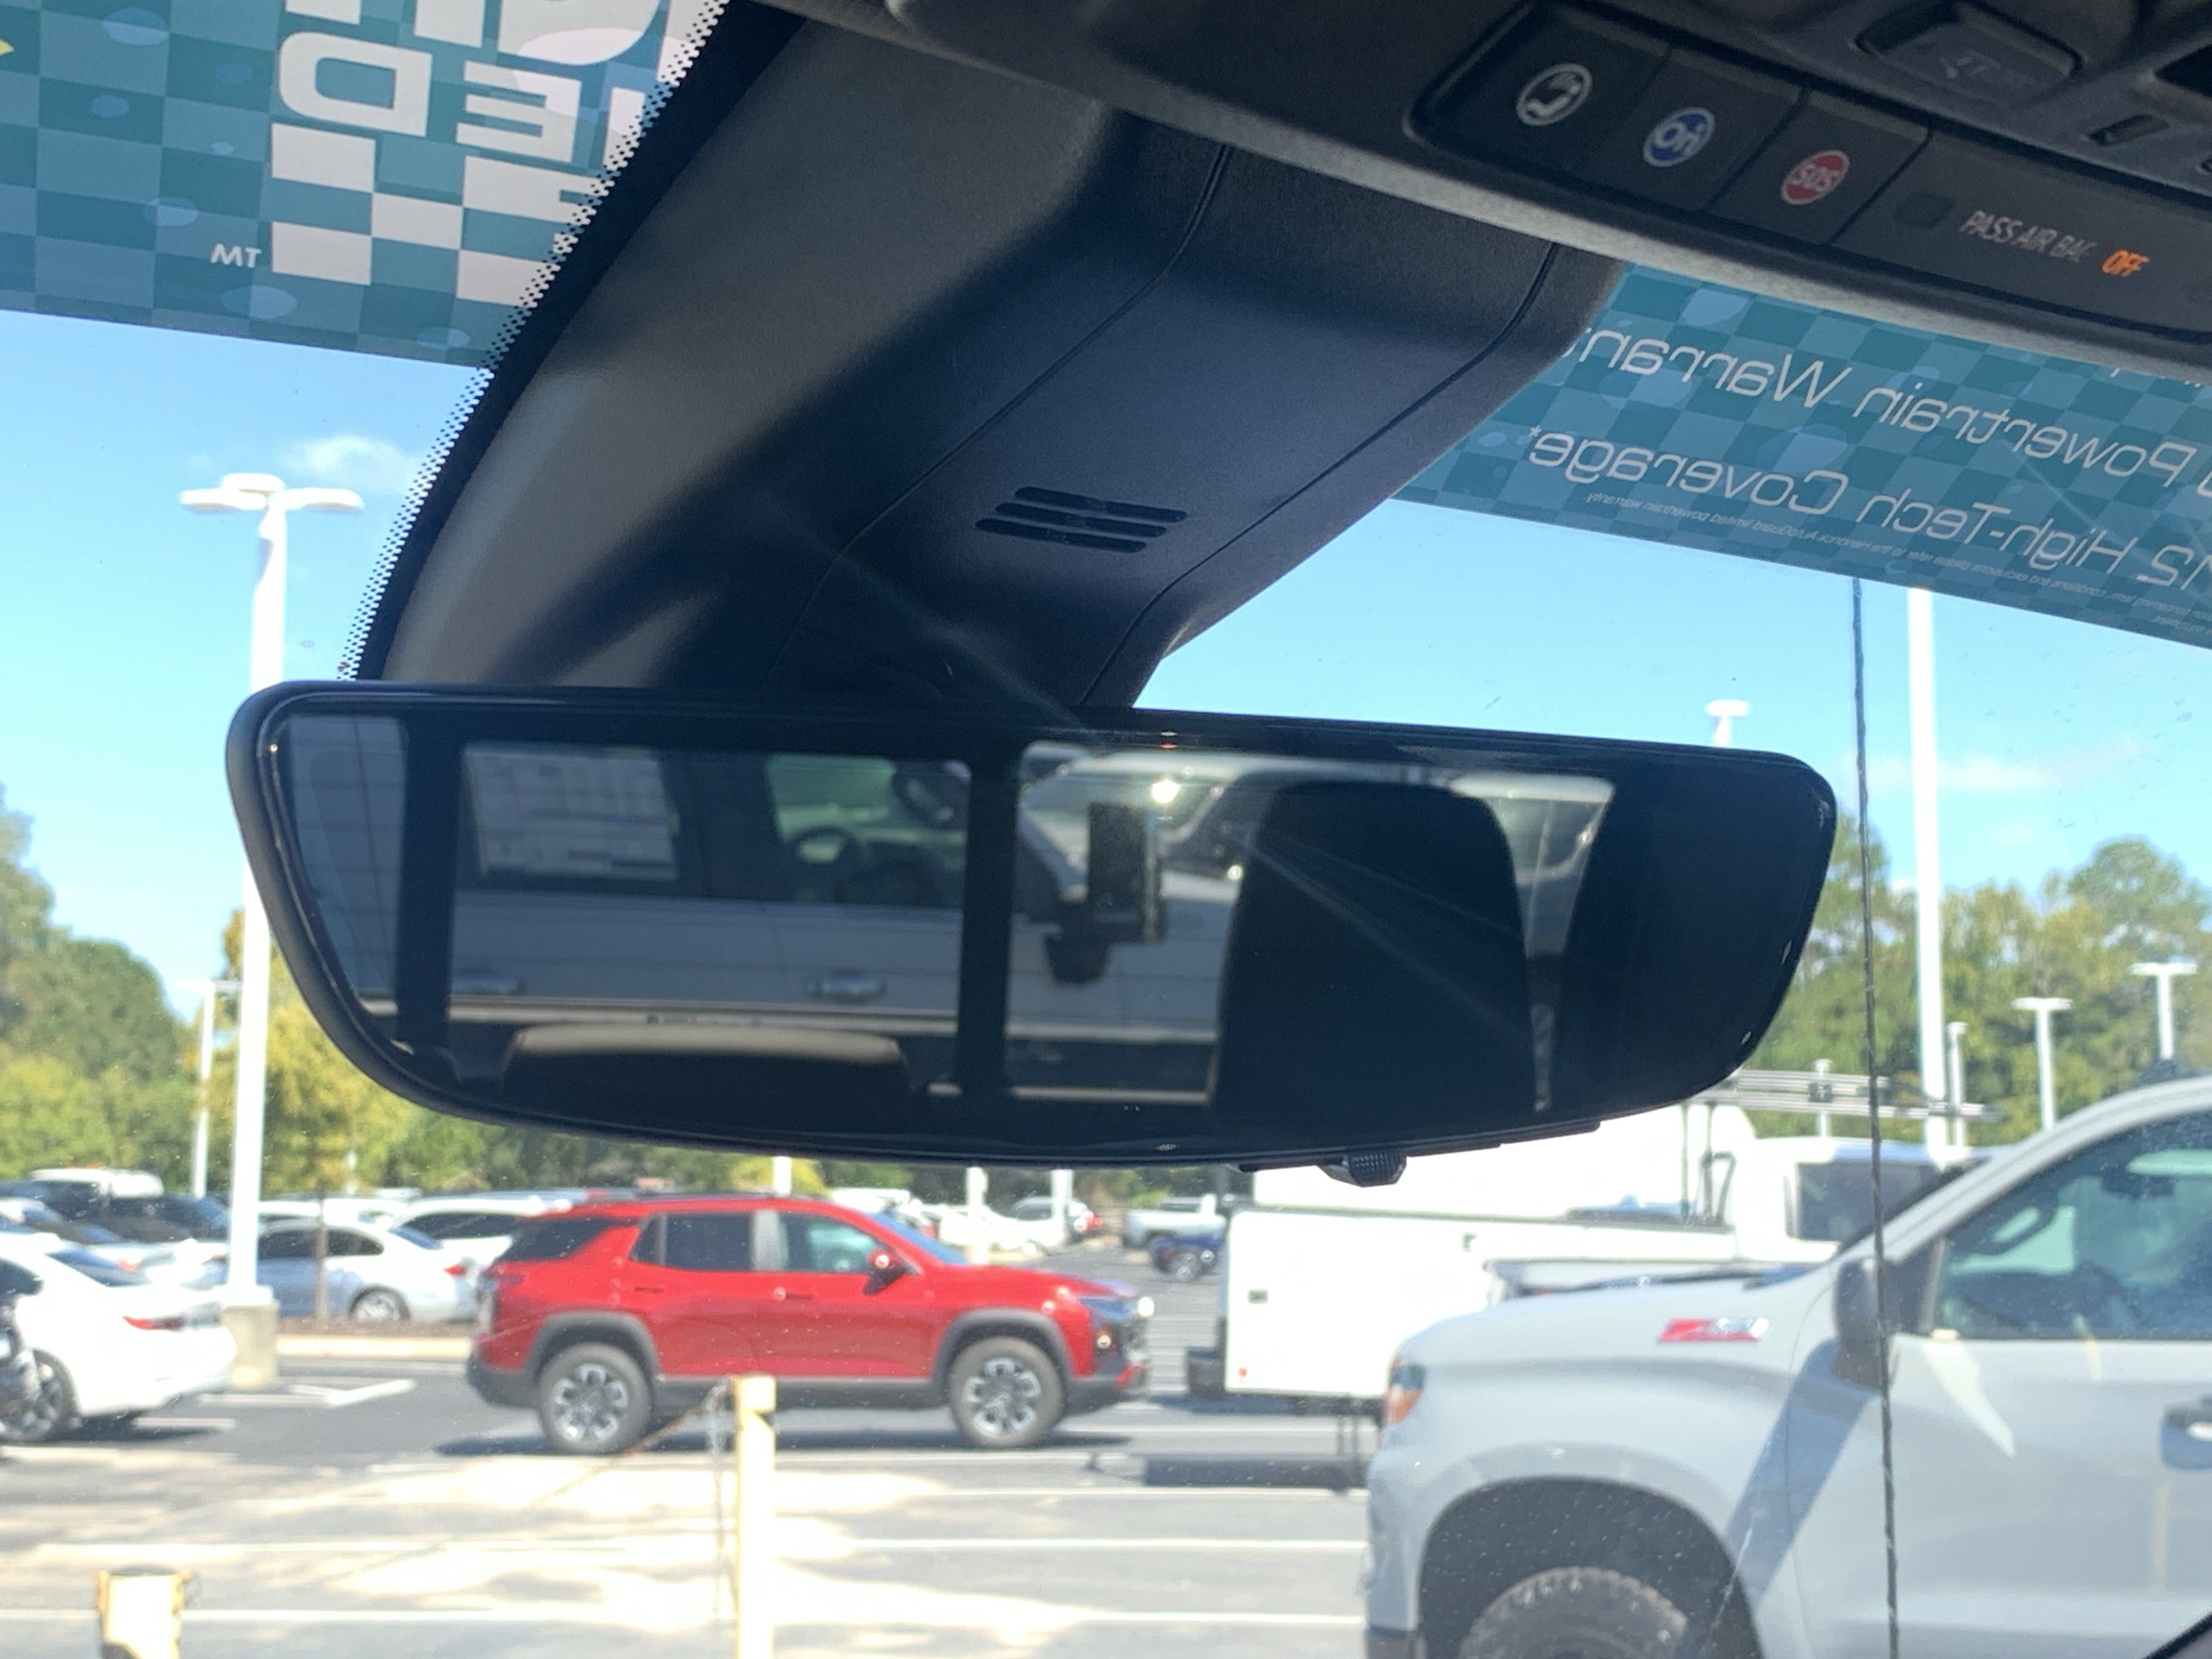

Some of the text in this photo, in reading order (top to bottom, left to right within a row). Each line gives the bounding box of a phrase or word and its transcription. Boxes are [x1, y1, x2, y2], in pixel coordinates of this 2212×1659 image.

[1790, 163, 1842, 192] SOS
[1959, 210, 2023, 244] PASS
[2010, 226, 2058, 253] AIR
[2101, 250, 2149, 277] OFF
